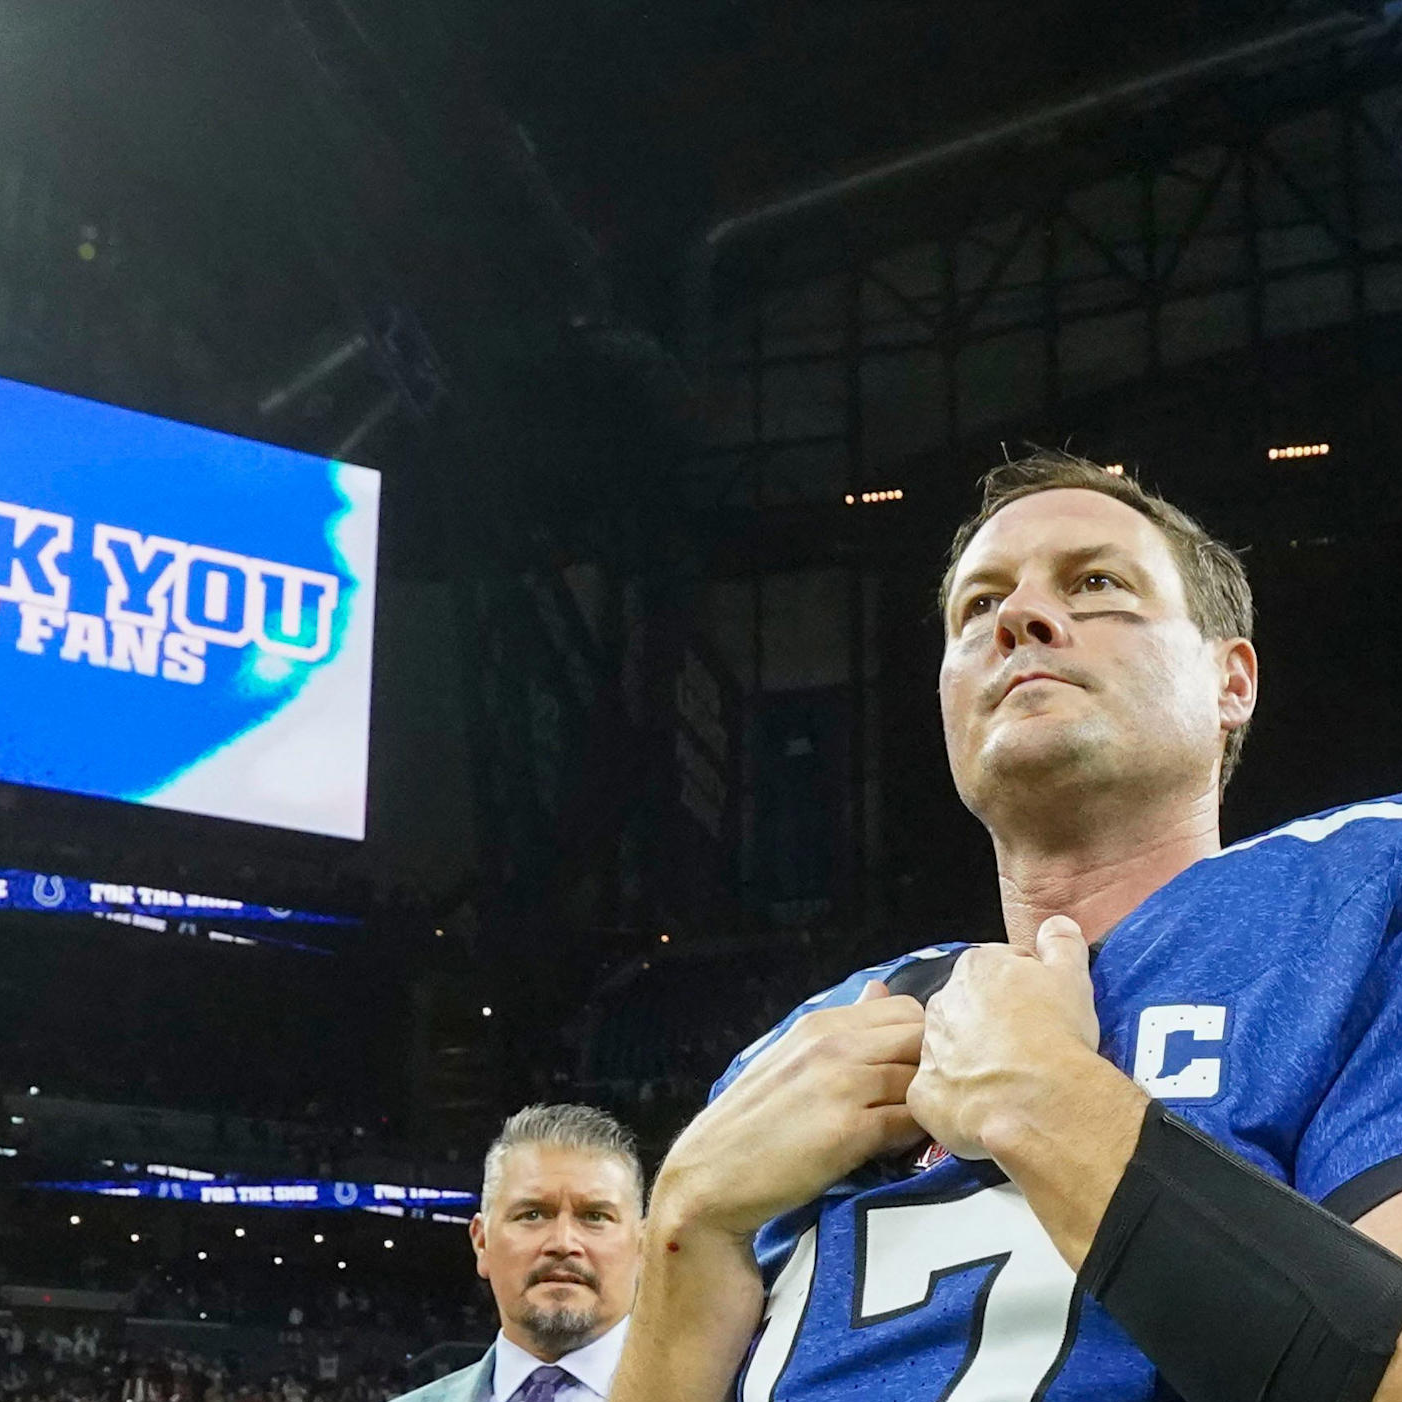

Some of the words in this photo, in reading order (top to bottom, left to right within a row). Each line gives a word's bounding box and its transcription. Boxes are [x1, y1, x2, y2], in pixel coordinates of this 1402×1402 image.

[93, 522, 338, 660] YOU
[18, 602, 207, 685] FANS
[1133, 1004, 1226, 1099] C
